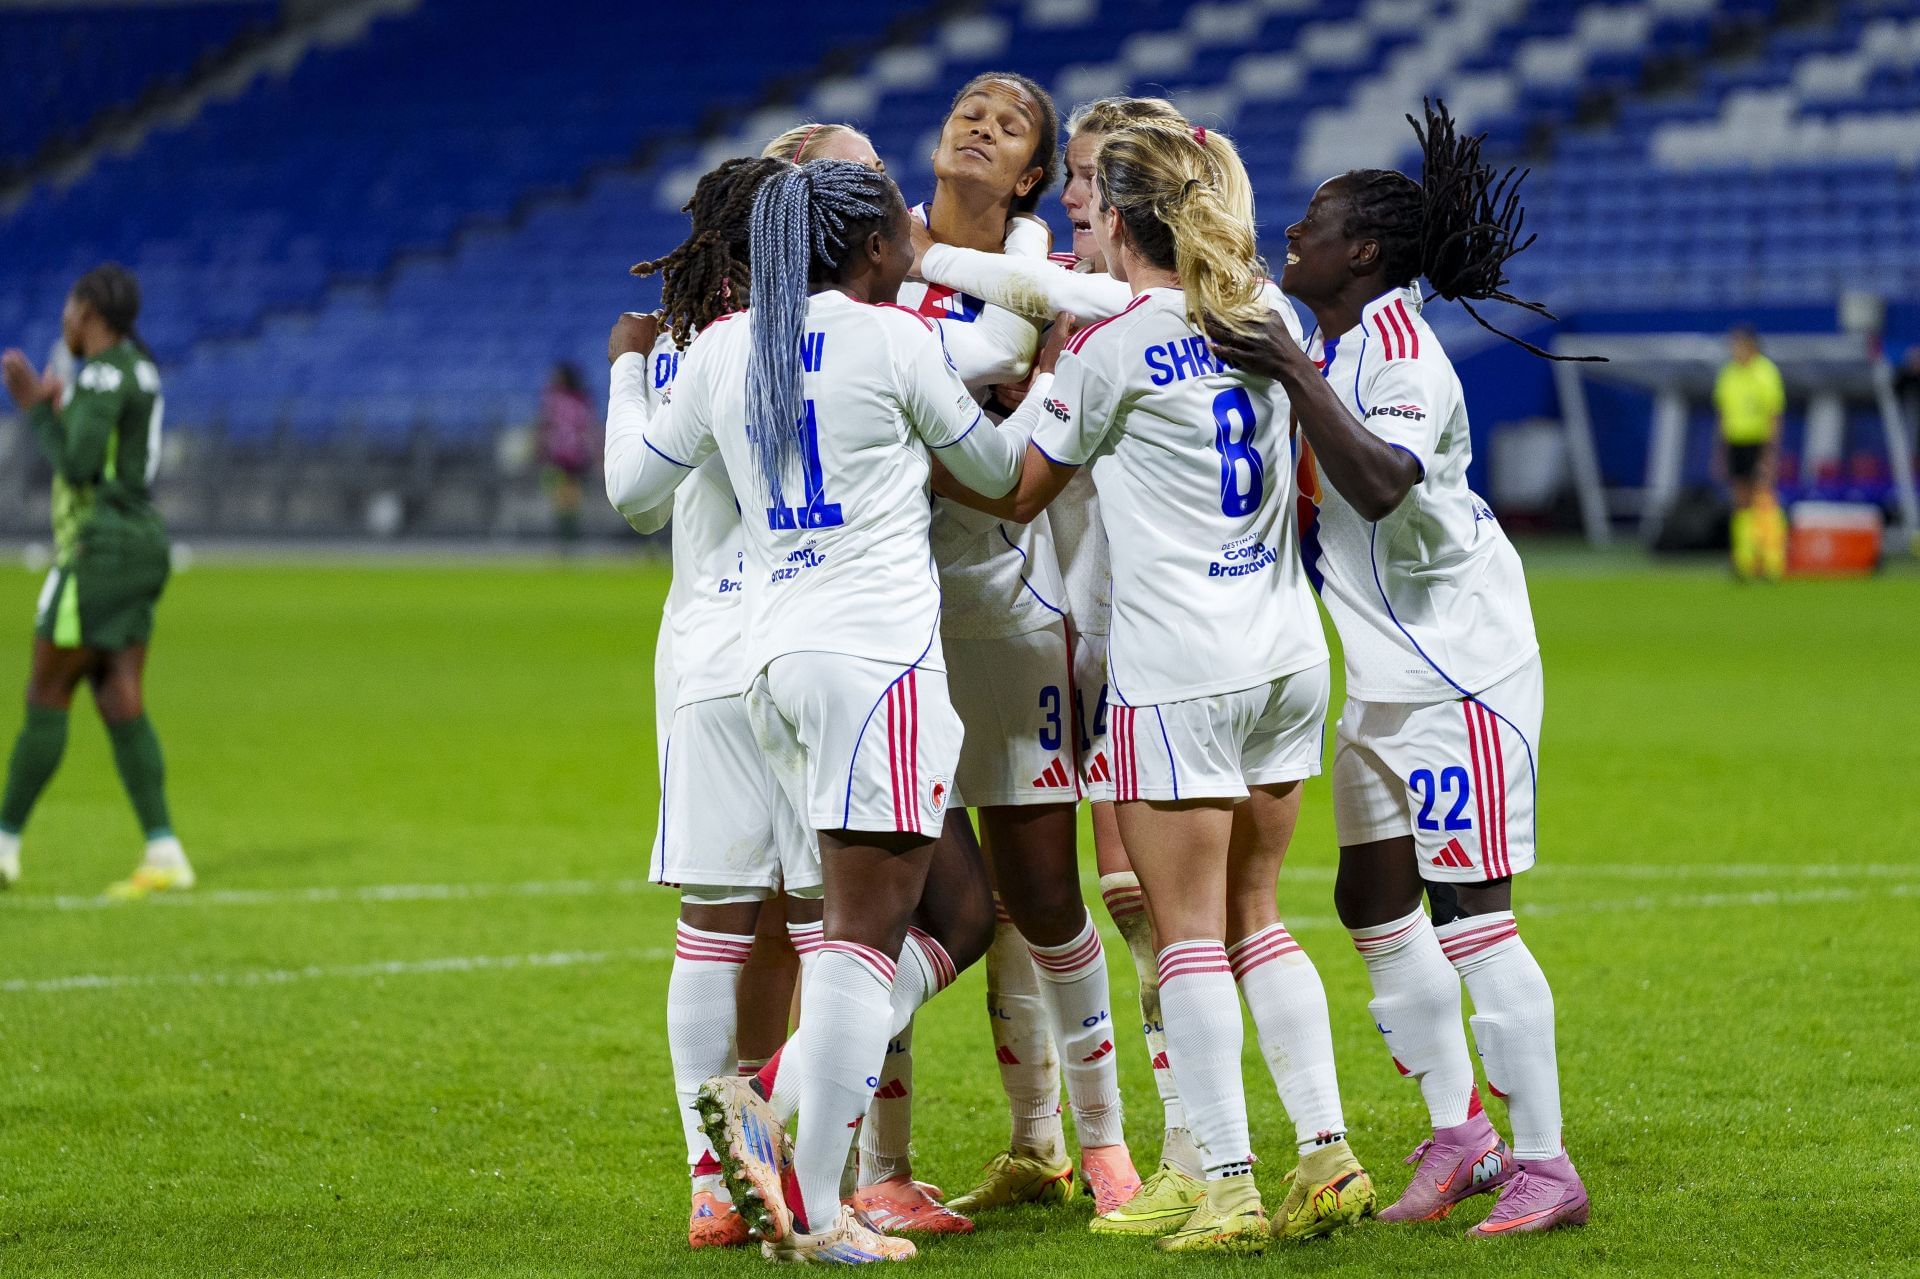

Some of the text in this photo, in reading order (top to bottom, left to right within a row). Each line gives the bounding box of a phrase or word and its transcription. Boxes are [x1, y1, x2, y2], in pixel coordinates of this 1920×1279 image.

[1043, 397, 1071, 423] ber
[1212, 387, 1264, 517] 8
[1221, 531, 1263, 551] DESTINATI
[1224, 542, 1266, 560] Congo
[1208, 547, 1278, 577] Brazzavill
[1039, 686, 1062, 751] 3
[1409, 766, 1472, 831] 22
[1082, 1011, 1109, 1027] OL
[1143, 1021, 1165, 1035] OL
[866, 1076, 880, 1089] O
